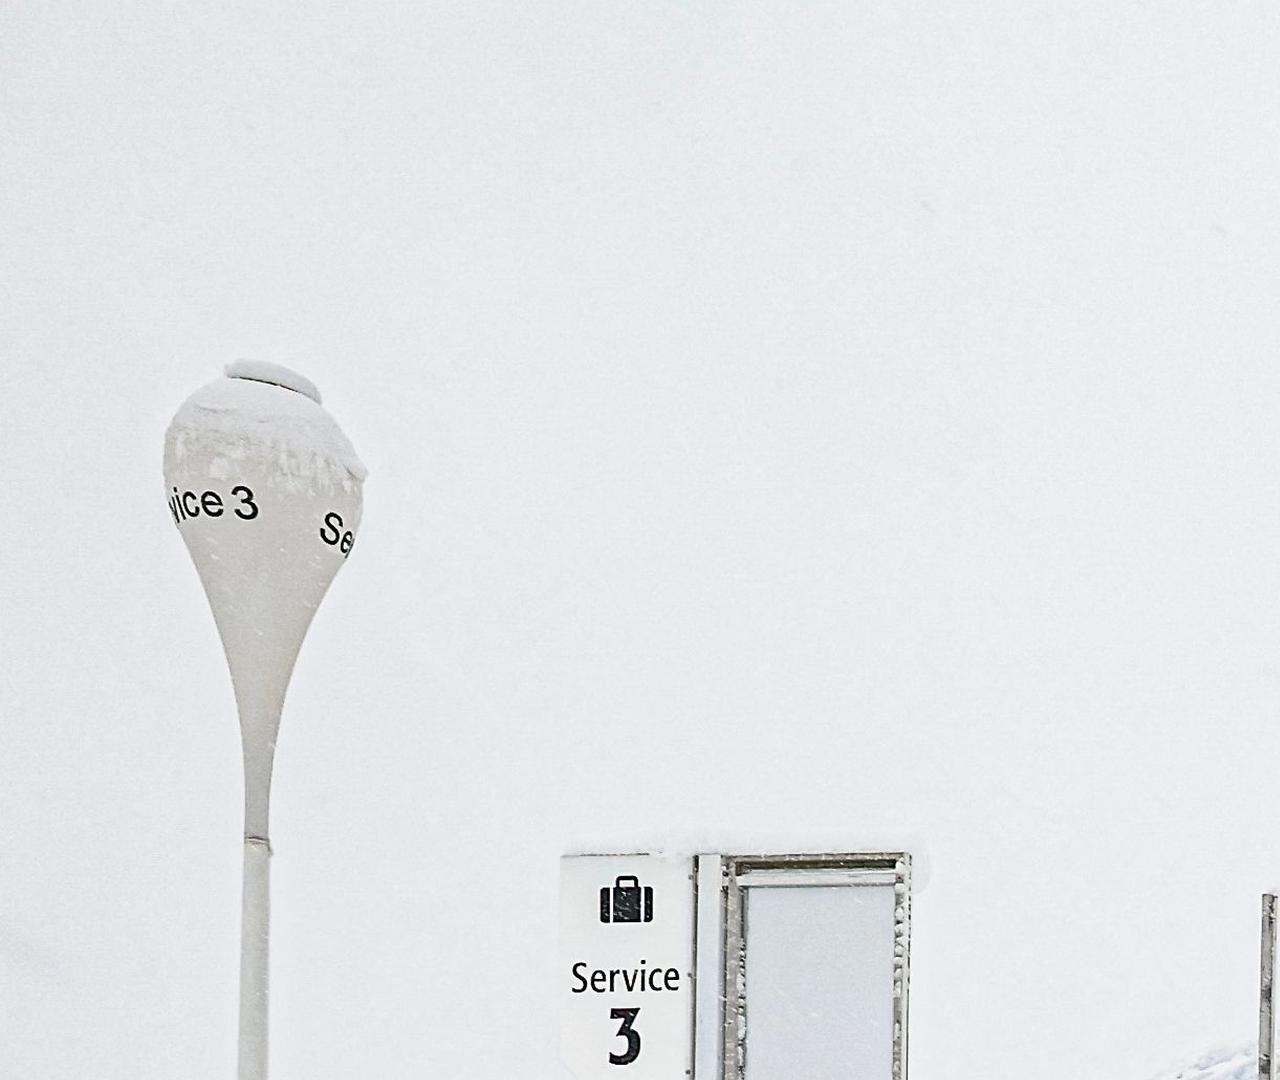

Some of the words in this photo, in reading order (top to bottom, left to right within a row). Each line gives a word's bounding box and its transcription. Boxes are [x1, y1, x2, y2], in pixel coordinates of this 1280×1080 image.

[231, 486, 259, 520] 3
[571, 959, 680, 993] Service
[608, 1006, 641, 1065] 3
